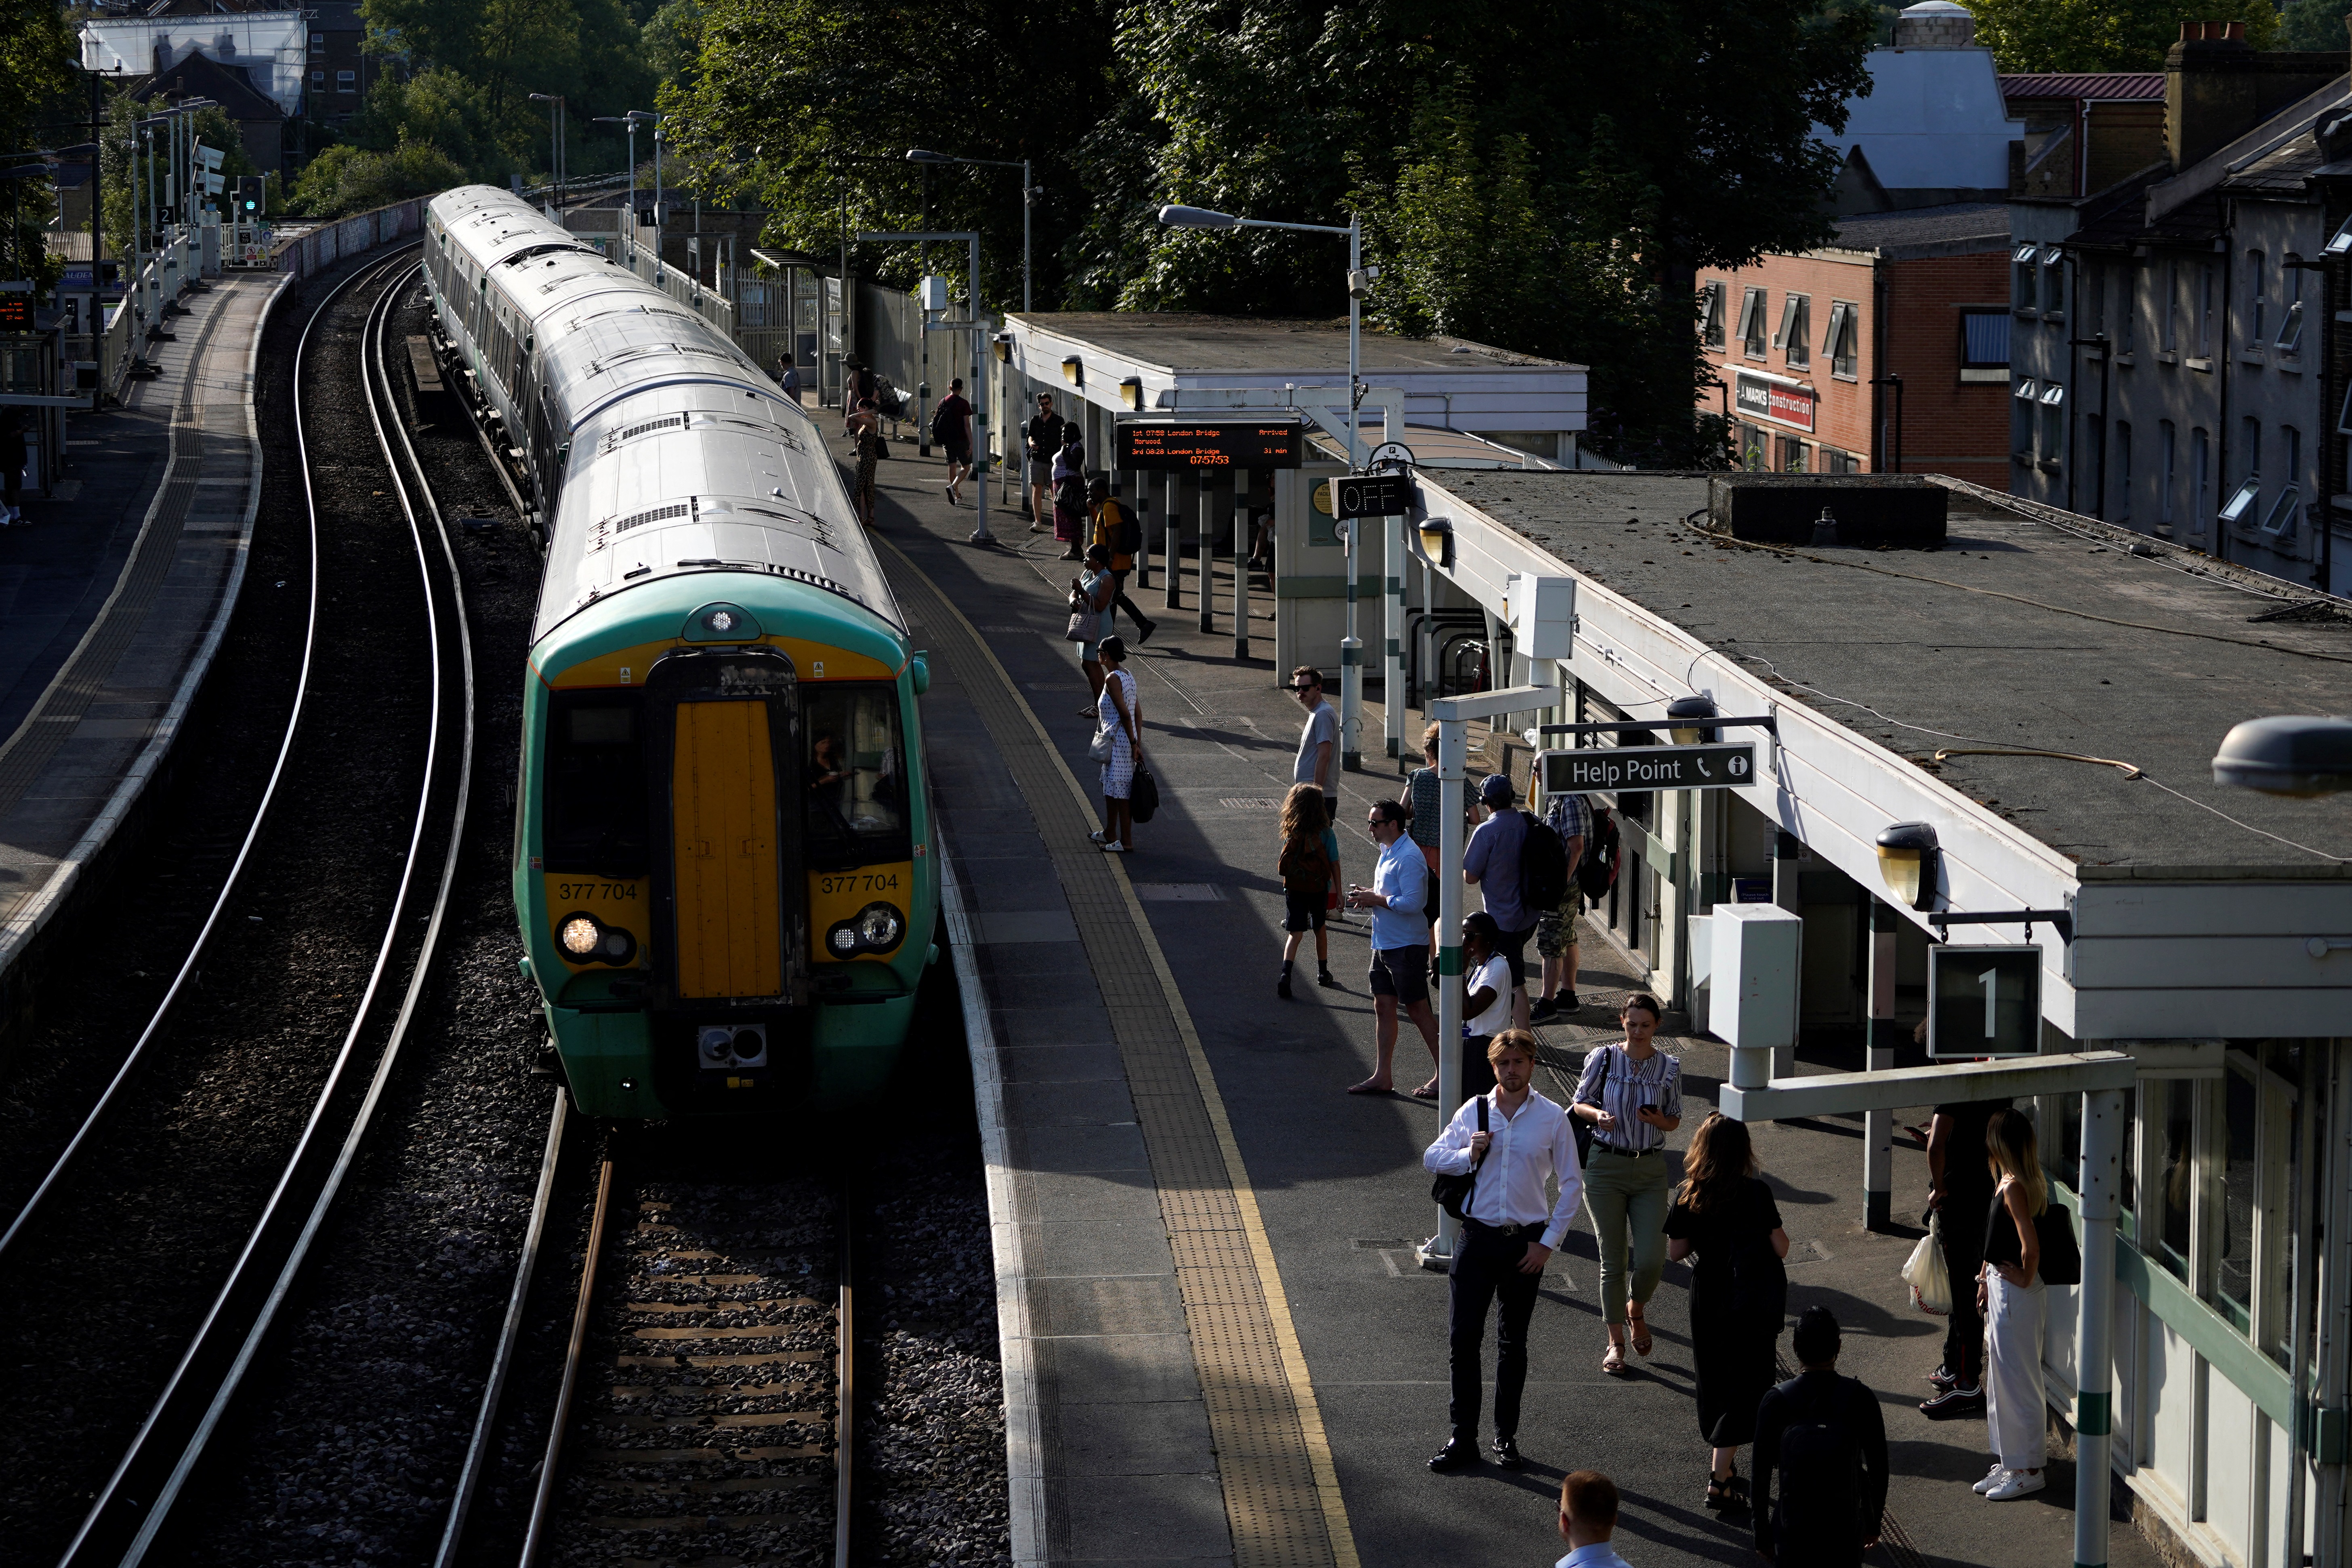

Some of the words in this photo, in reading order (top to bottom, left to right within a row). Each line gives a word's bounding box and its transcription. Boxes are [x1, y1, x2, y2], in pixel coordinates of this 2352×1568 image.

[162, 209, 169, 222] 2
[646, 212, 650, 224] 1
[1769, 394, 1810, 415] construction
[1190, 456, 1229, 464] 07:57:53
[1344, 484, 1395, 511] OFF
[1573, 761, 1620, 787] Help
[1627, 759, 1681, 780] Point
[560, 883, 595, 900] 377
[601, 883, 637, 900] 704
[822, 876, 857, 893] 377
[862, 874, 898, 891] 704
[1978, 967, 1996, 1038] 1
